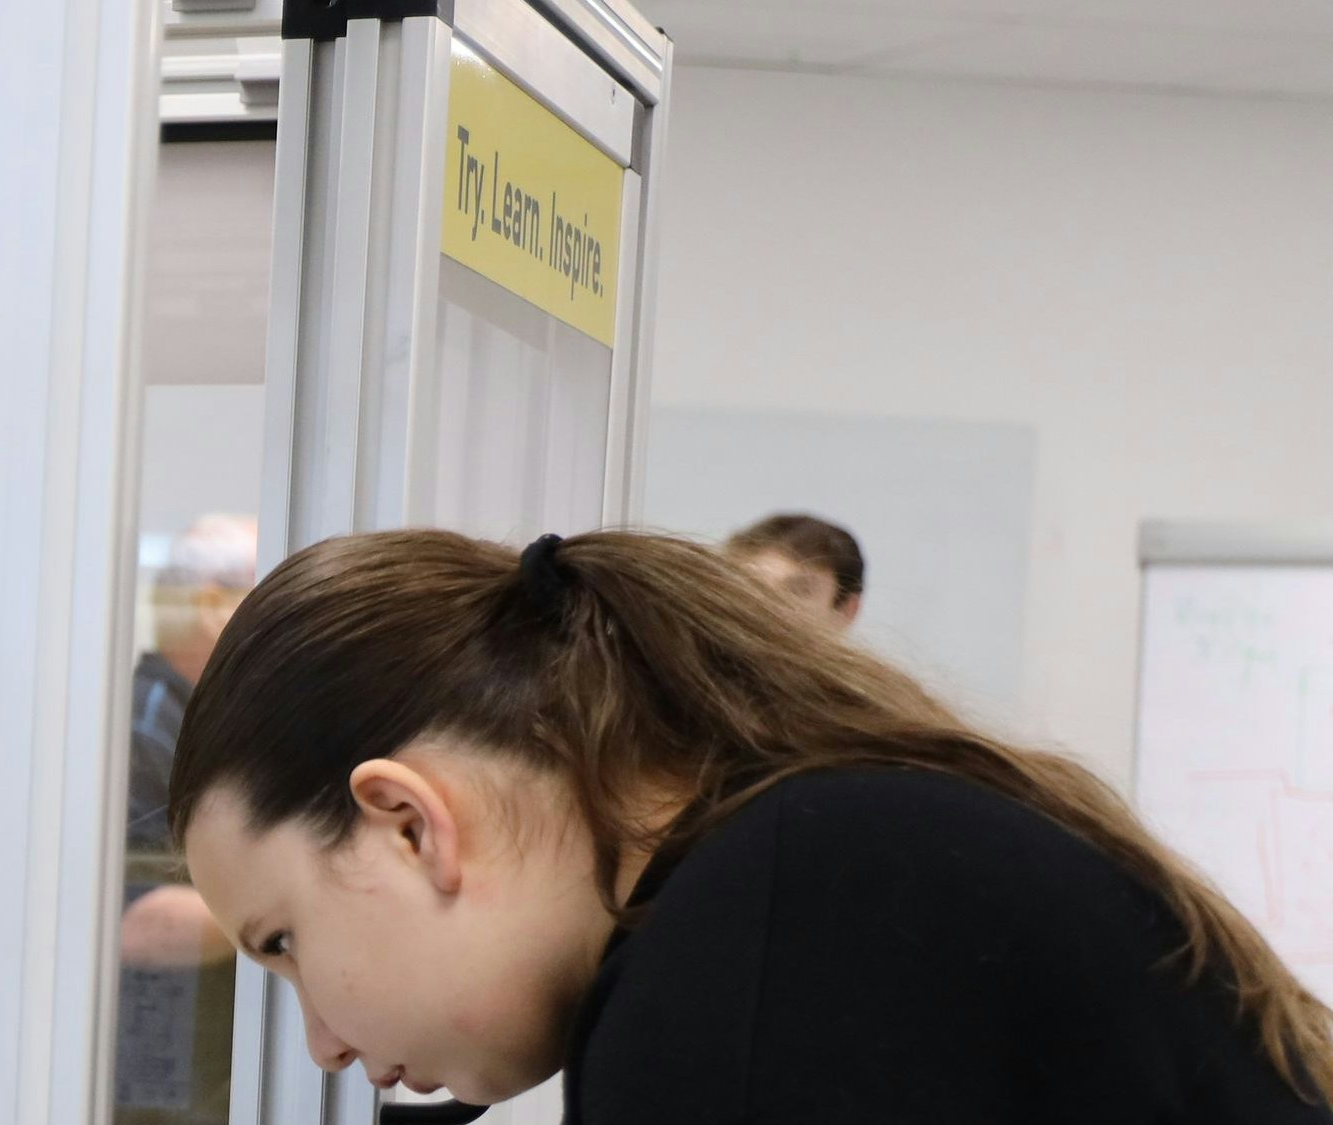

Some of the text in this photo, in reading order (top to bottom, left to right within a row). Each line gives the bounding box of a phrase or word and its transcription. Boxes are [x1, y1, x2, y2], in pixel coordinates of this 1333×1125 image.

[457, 124, 604, 301] Try. Learn. Inspire.
